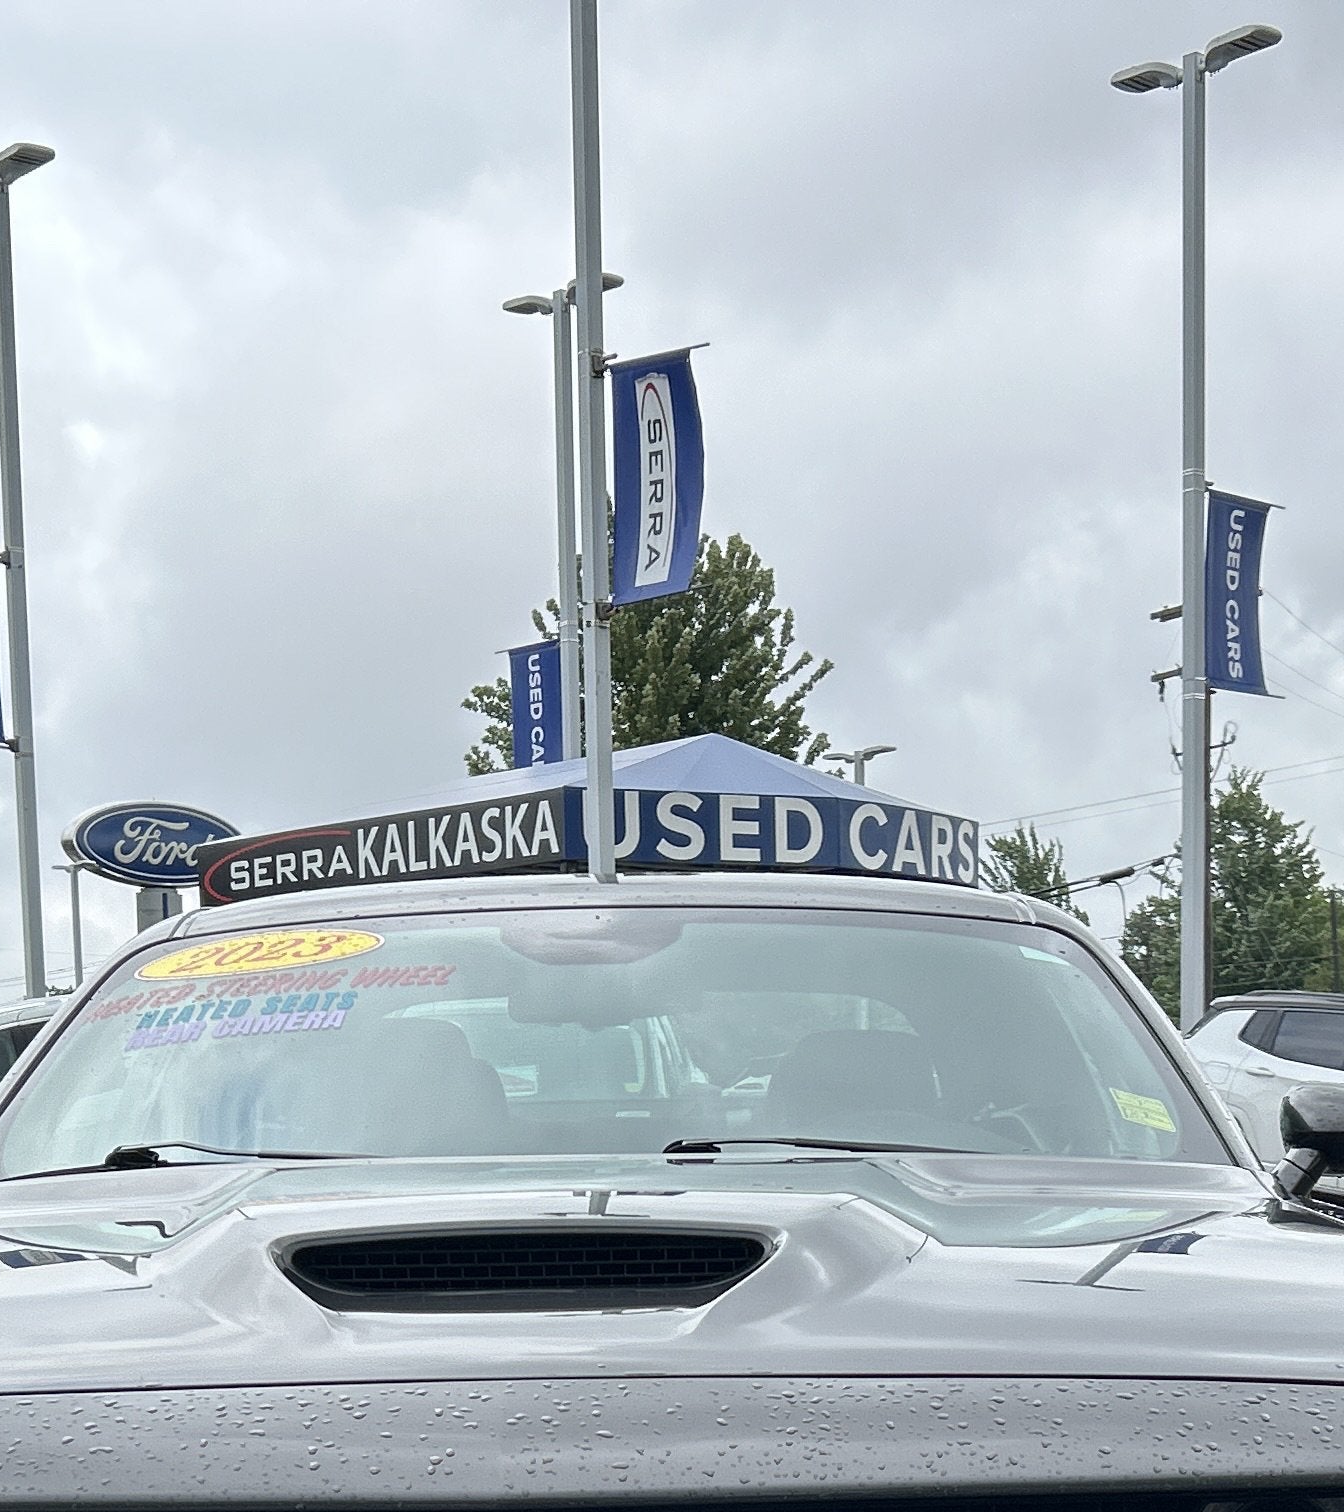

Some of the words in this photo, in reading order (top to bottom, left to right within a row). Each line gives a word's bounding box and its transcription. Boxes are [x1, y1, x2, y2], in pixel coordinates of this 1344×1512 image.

[643, 418, 664, 571] SERRA
[1225, 509, 1246, 592] USED
[1225, 599, 1244, 679] CARS
[527, 653, 544, 720] USED
[530, 726, 545, 767] CA
[229, 848, 354, 892] SERRA
[357, 799, 561, 880] KALKASKA
[581, 788, 825, 864] USED
[848, 803, 978, 885] CARS
[169, 933, 348, 975] 2023
[197, 967, 349, 1001] STEERING
[351, 964, 457, 989] WHEEL
[124, 1017, 208, 1053] REAR
[212, 1010, 348, 1039] CAMERA
[135, 997, 255, 1031] HEATED
[261, 990, 358, 1015] SEATS
